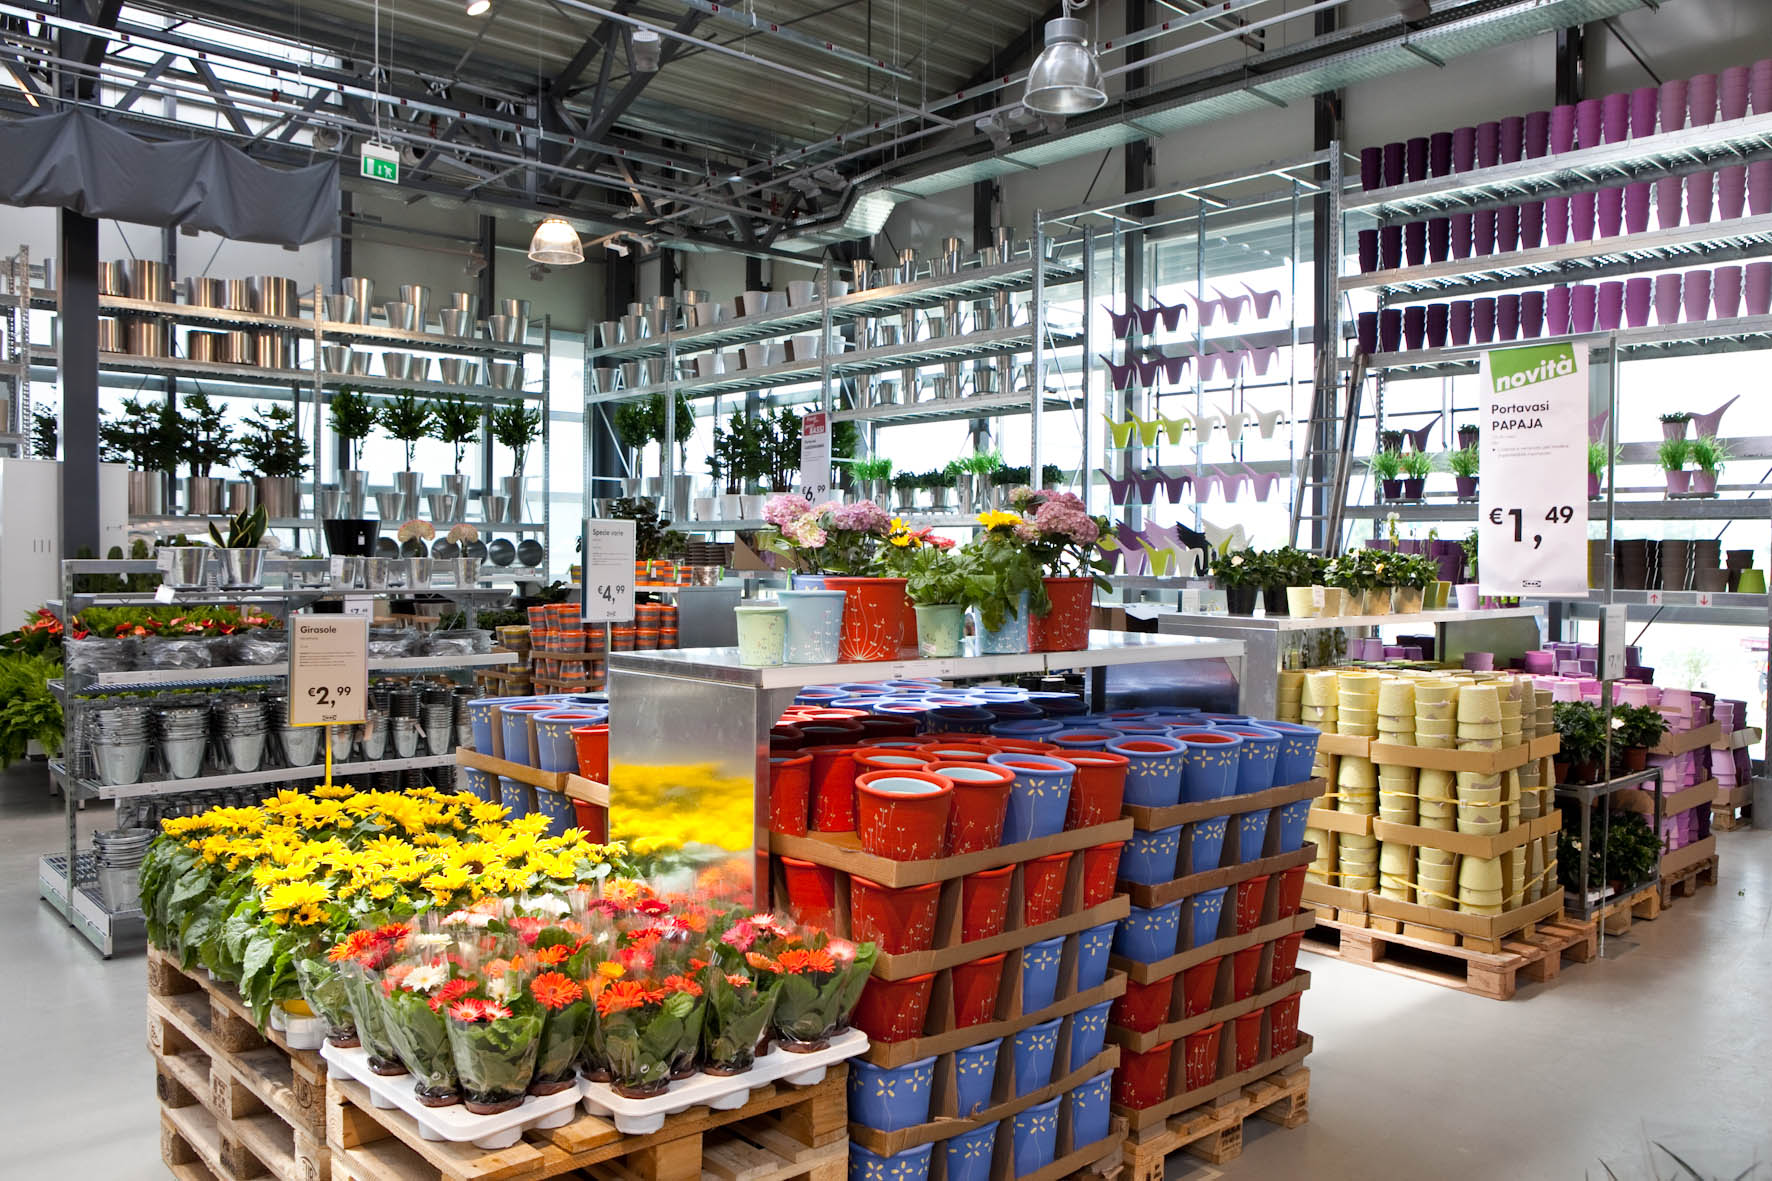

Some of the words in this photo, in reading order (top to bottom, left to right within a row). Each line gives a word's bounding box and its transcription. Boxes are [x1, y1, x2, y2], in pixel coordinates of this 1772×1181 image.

[1496, 354, 1573, 392] novità
[1491, 400, 1550, 415] Portavasi
[1491, 418, 1543, 431] PAPAJA
[592, 528, 610, 537] Specie
[1489, 505, 1574, 550] €1,49
[597, 584, 625, 605] €4,99
[300, 625, 337, 634] Girasole
[308, 686, 351, 708] €2,99
